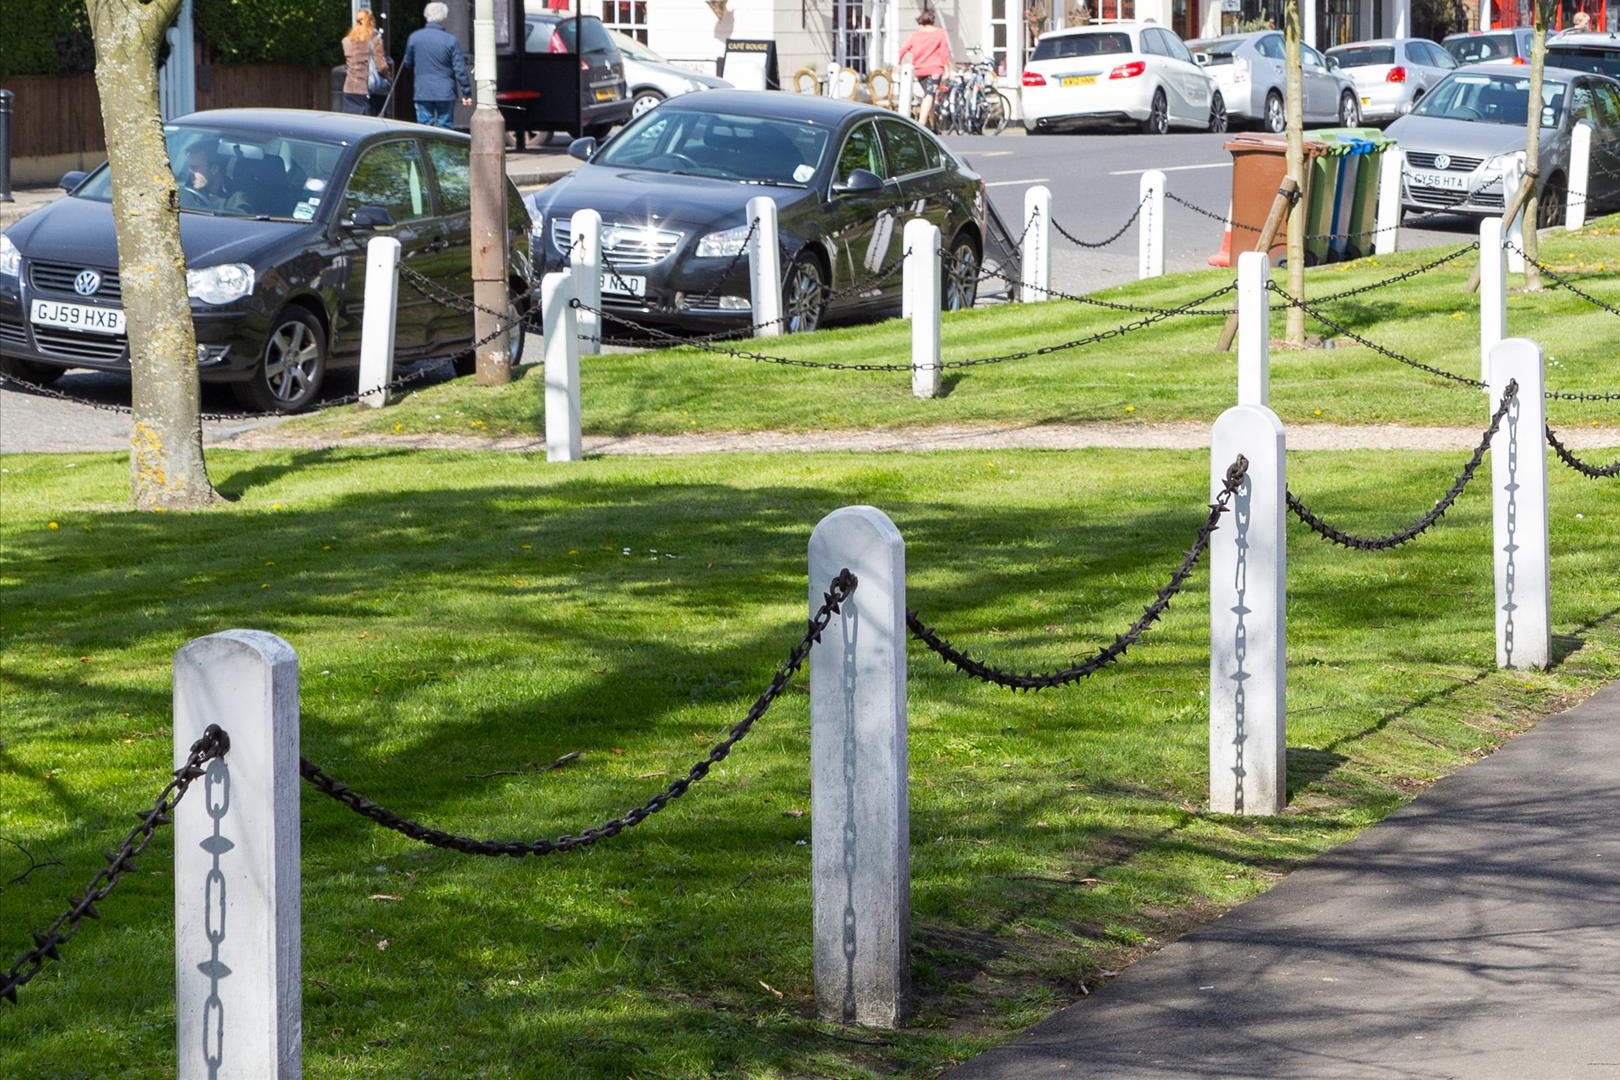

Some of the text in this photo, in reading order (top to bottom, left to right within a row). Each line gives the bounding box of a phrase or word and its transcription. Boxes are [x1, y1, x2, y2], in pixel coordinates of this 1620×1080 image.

[1443, 176, 1462, 187] HTA
[38, 304, 117, 328] GJ59 HXB
